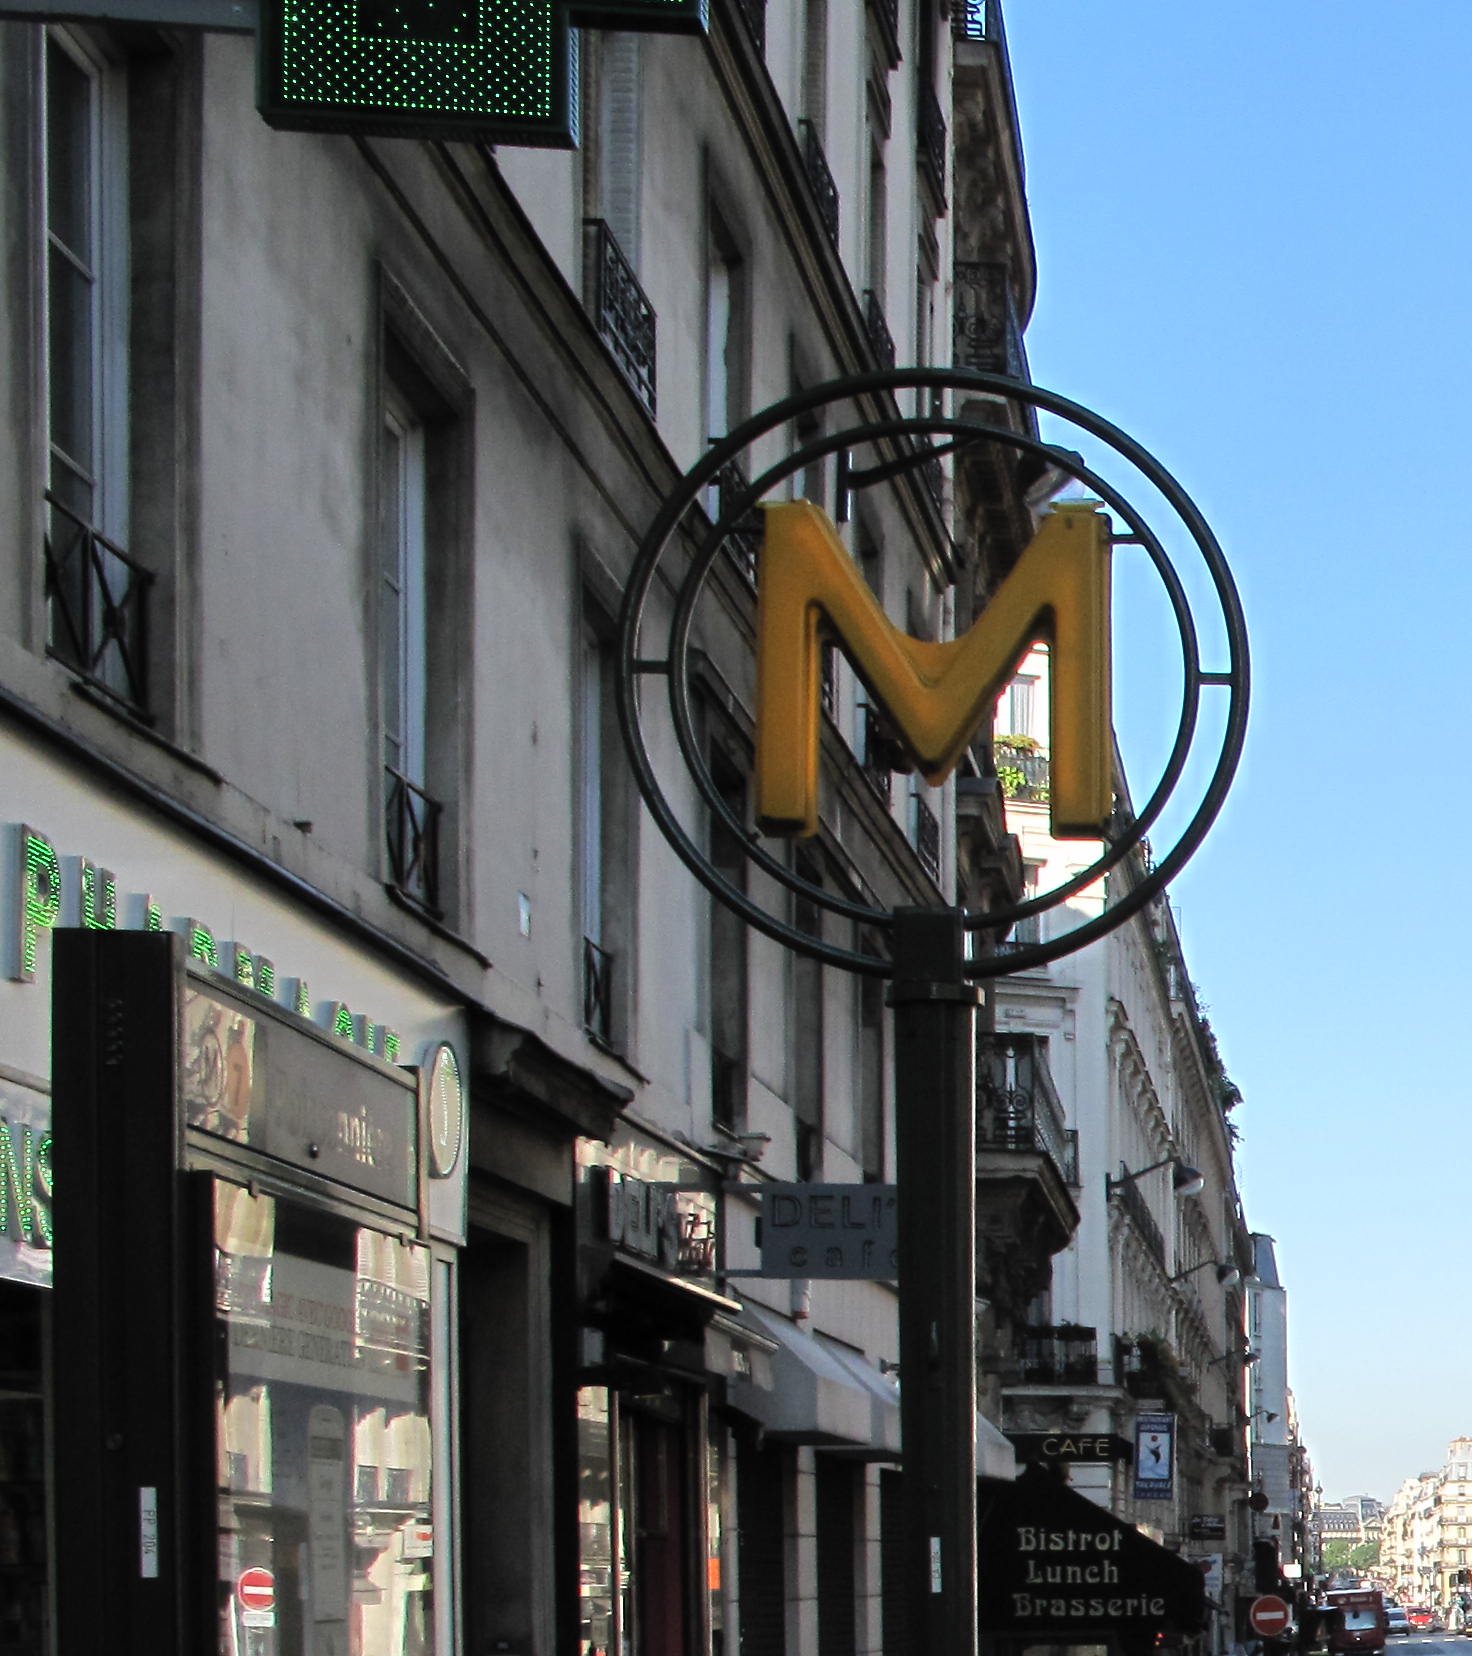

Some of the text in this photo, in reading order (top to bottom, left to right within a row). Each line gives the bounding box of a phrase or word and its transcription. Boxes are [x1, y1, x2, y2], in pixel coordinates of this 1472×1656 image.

[755, 500, 1112, 839] M
[1017, 1527, 1123, 1551] Bistrot
[1026, 1560, 1121, 1584] Lunch
[1012, 1593, 1165, 1616] Brasserie
